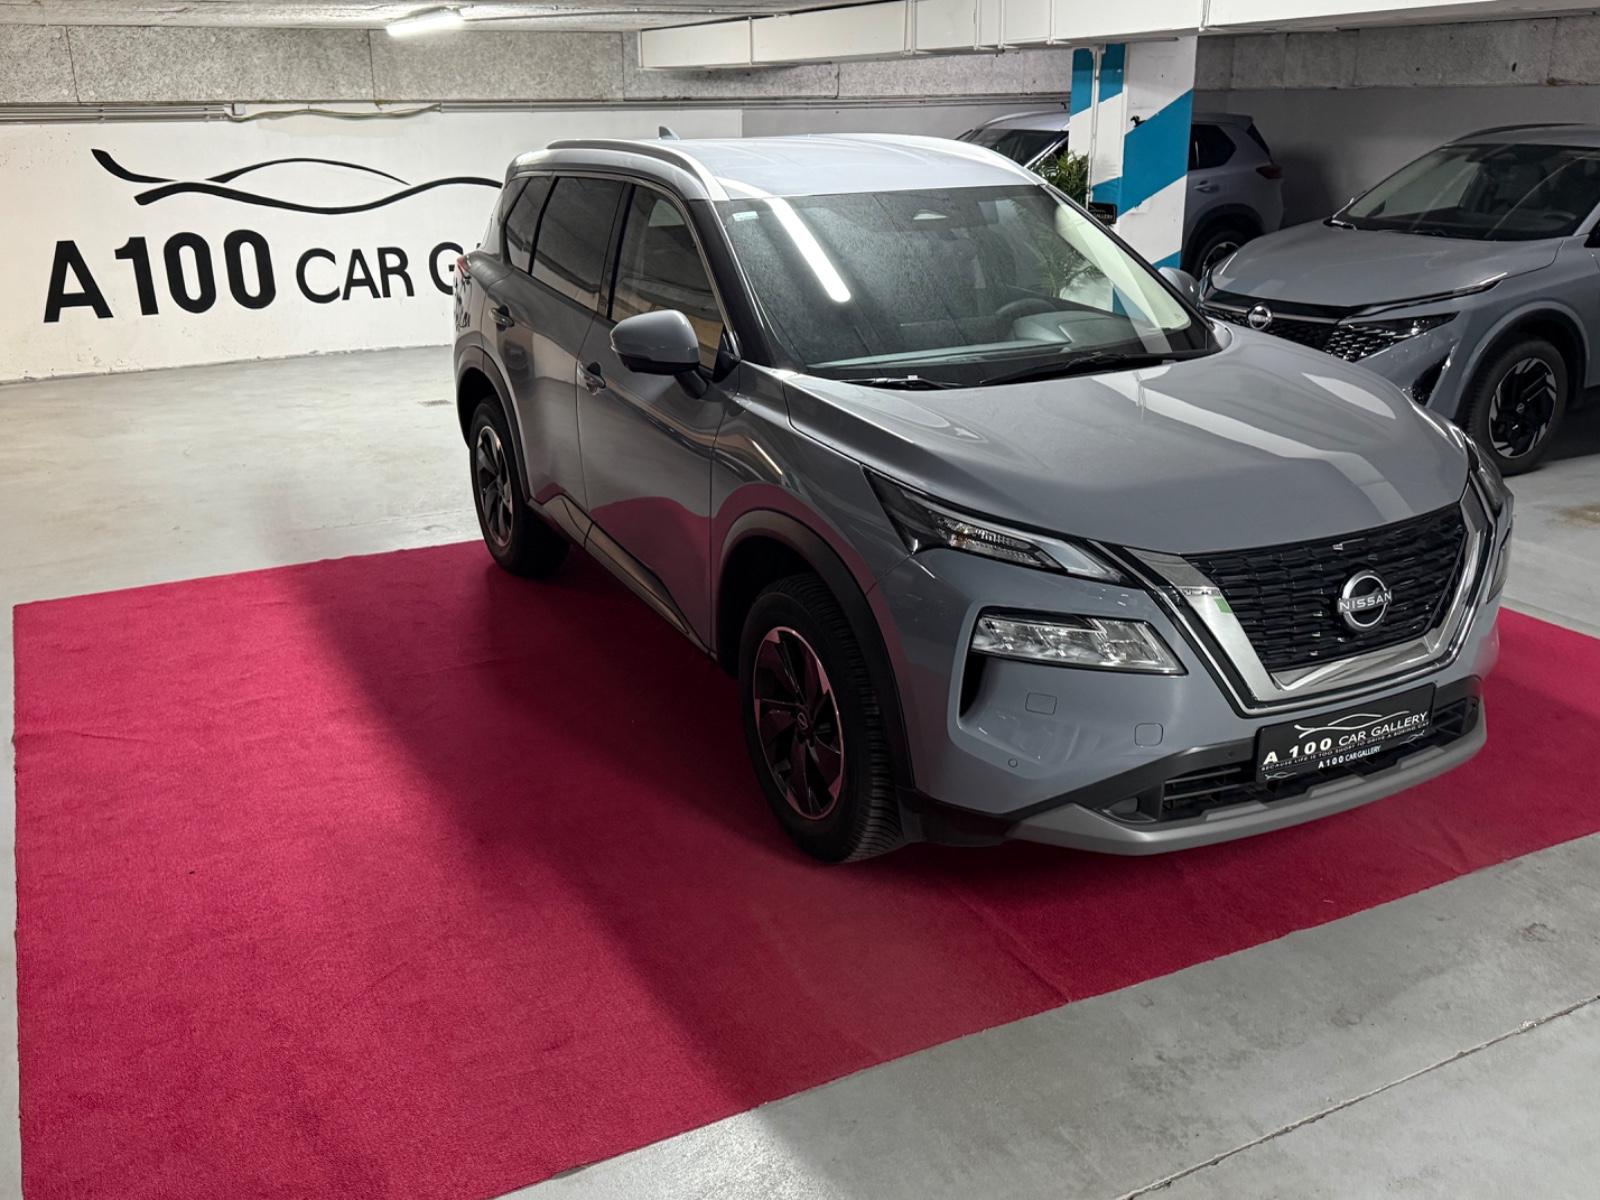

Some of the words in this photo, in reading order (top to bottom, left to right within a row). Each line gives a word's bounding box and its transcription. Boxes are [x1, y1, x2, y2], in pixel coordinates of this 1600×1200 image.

[295, 246, 415, 304] CAR
[1339, 591, 1392, 611] NISSAN
[1338, 730, 1367, 746] CAR
[1370, 711, 1428, 737] GALLERY
